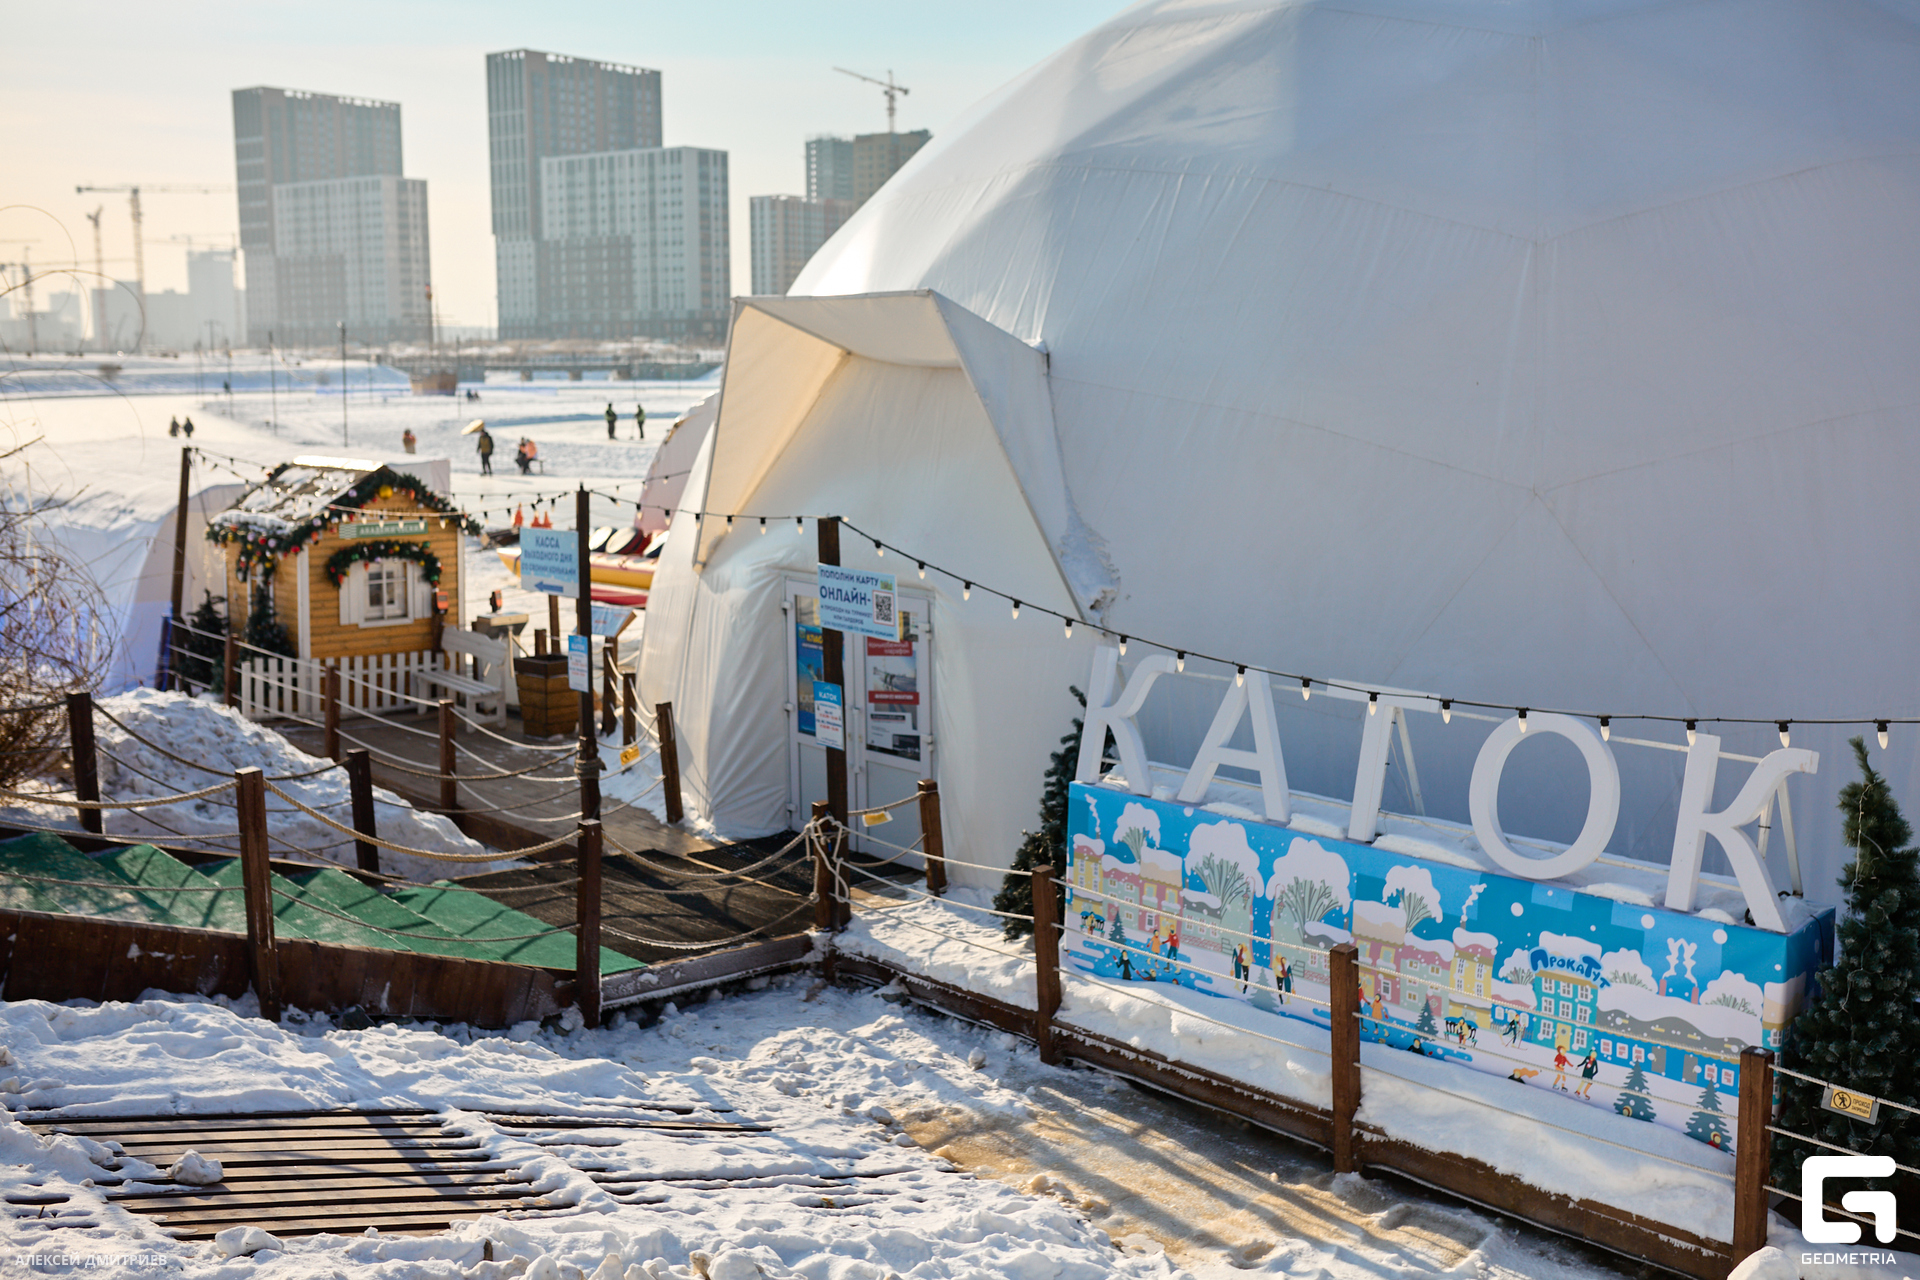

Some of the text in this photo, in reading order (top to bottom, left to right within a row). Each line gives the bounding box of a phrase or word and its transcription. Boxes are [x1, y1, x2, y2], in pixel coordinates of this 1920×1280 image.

[535, 535, 560, 549] КАССА
[524, 549, 573, 563] ВЫХОДНОГО ДНЯ
[820, 569, 879, 586] ПОПОЛНИ КАРТУ
[820, 585, 871, 606] ОНЛАЙН-
[818, 691, 838, 701] КАТОК
[1074, 644, 1820, 933] КАТОК
[1852, 1098, 1871, 1109] ПРОХОД
